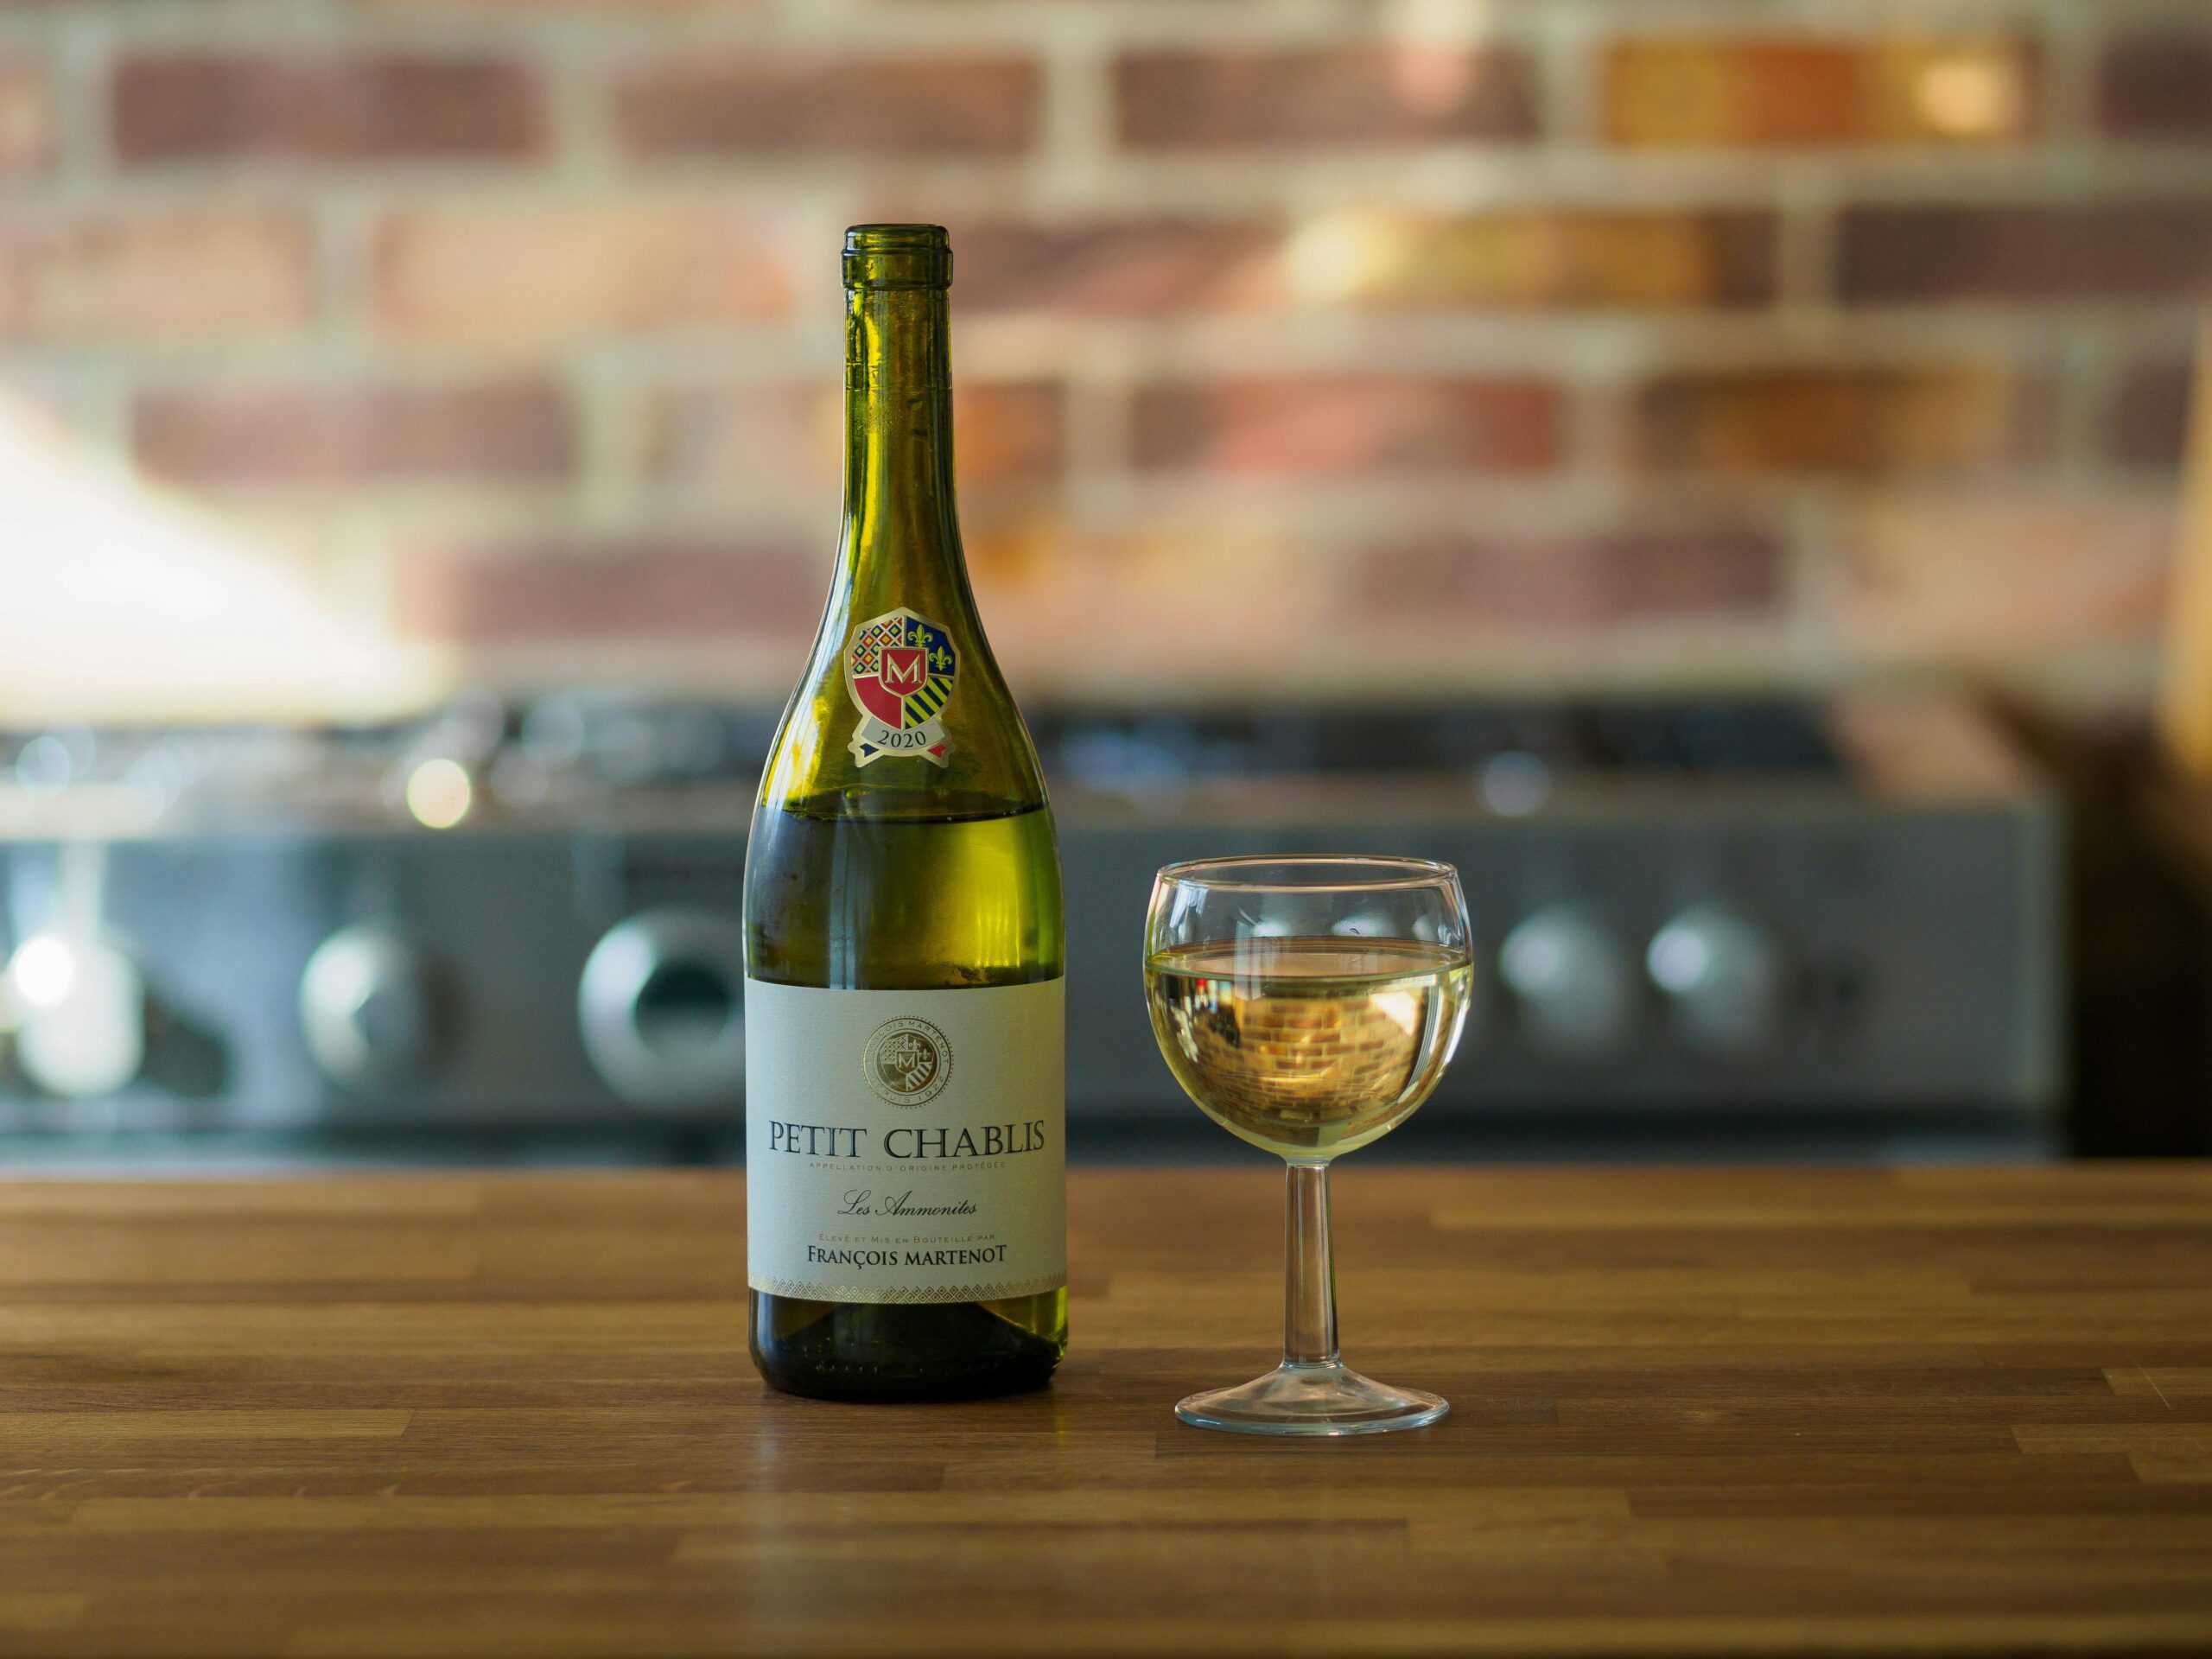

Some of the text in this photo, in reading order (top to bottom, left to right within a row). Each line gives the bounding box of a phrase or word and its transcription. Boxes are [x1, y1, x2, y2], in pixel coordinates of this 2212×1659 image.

[885, 652, 922, 684] M
[877, 730, 926, 748] 2020
[909, 1021, 949, 1064] MARTENOT
[899, 1052, 916, 1069] M
[768, 1120, 1045, 1159] PETIT CHABLIS
[809, 1160, 1006, 1173] APPELLATION D'ORIGINE PROTÉGÉE
[837, 1189, 978, 1217] Les Ammonites
[807, 1244, 1007, 1270] FRANÇOIS MARTENOT
